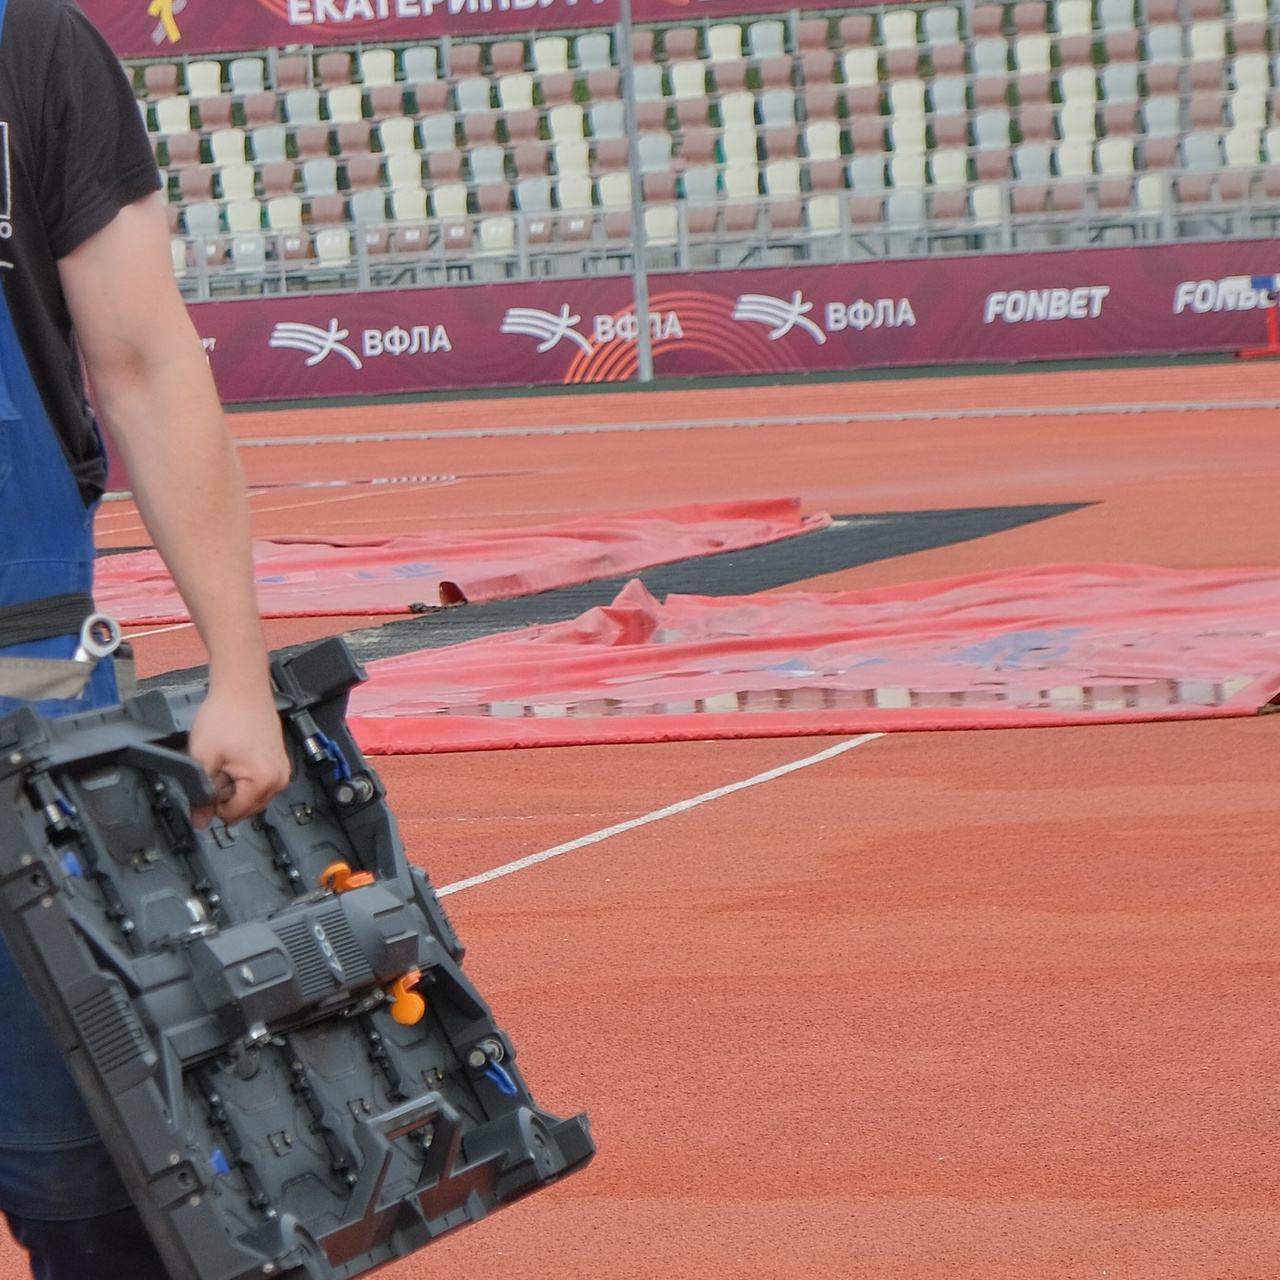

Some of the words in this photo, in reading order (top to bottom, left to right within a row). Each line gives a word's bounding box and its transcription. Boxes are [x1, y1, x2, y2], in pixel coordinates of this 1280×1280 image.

[825, 298, 917, 331] ВФЛА
[983, 285, 1110, 323] FONBET
[361, 324, 452, 357] ВФЛА
